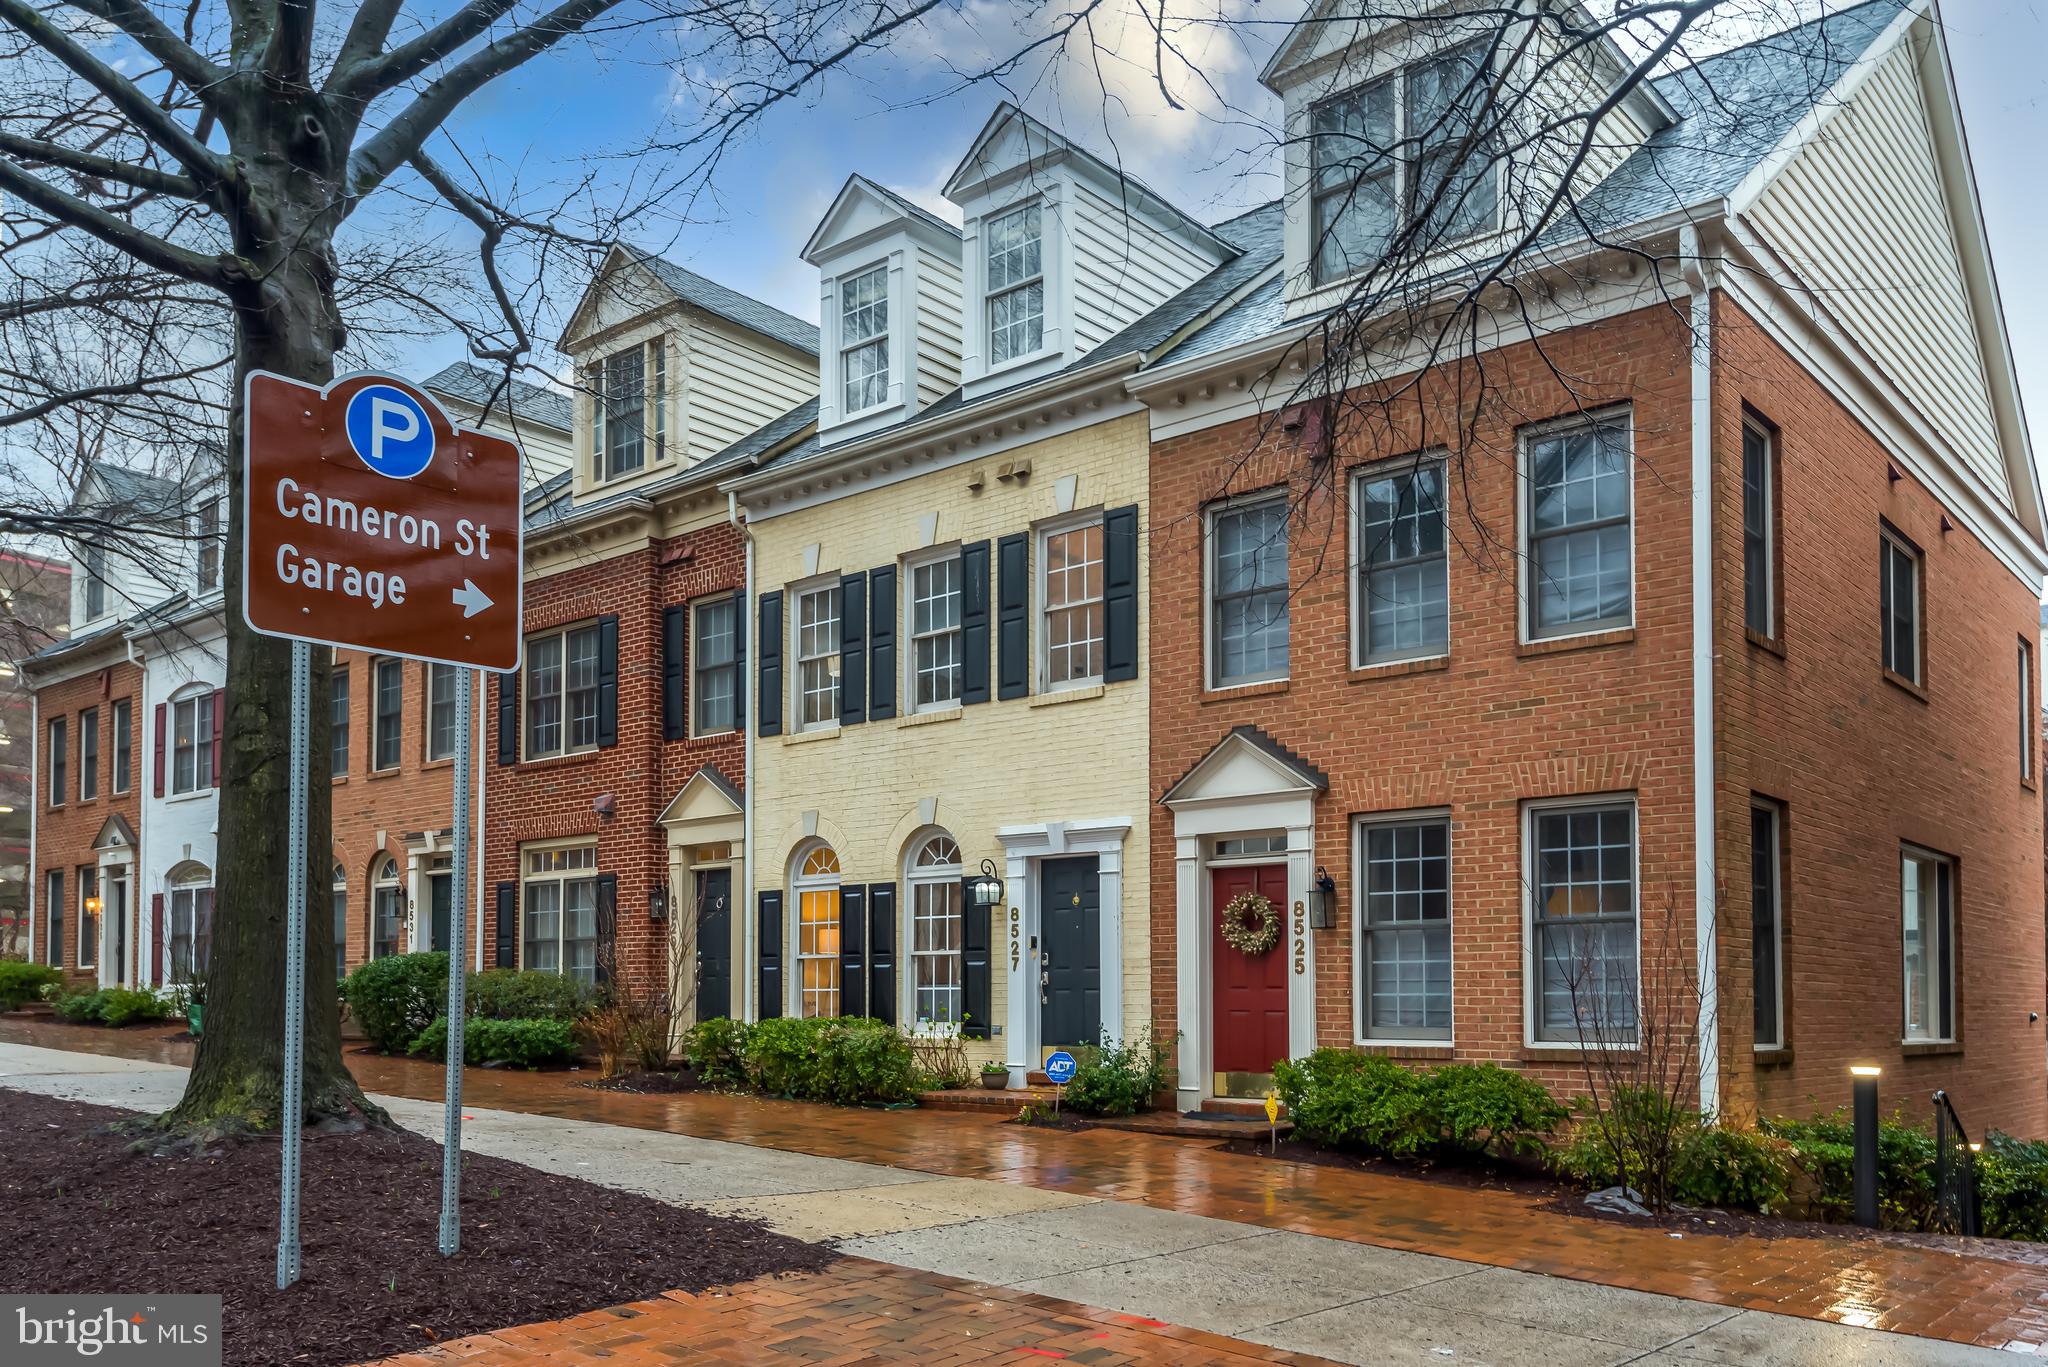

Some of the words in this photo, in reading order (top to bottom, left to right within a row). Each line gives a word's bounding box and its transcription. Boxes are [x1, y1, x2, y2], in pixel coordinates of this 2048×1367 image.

[371, 396, 420, 459] P
[276, 477, 440, 550] Cameron
[454, 519, 491, 560] St
[276, 543, 407, 609] Garage
[1010, 907, 1020, 972] 8527
[1293, 900, 1306, 975] 8525
[1048, 1060, 1074, 1073] ADT
